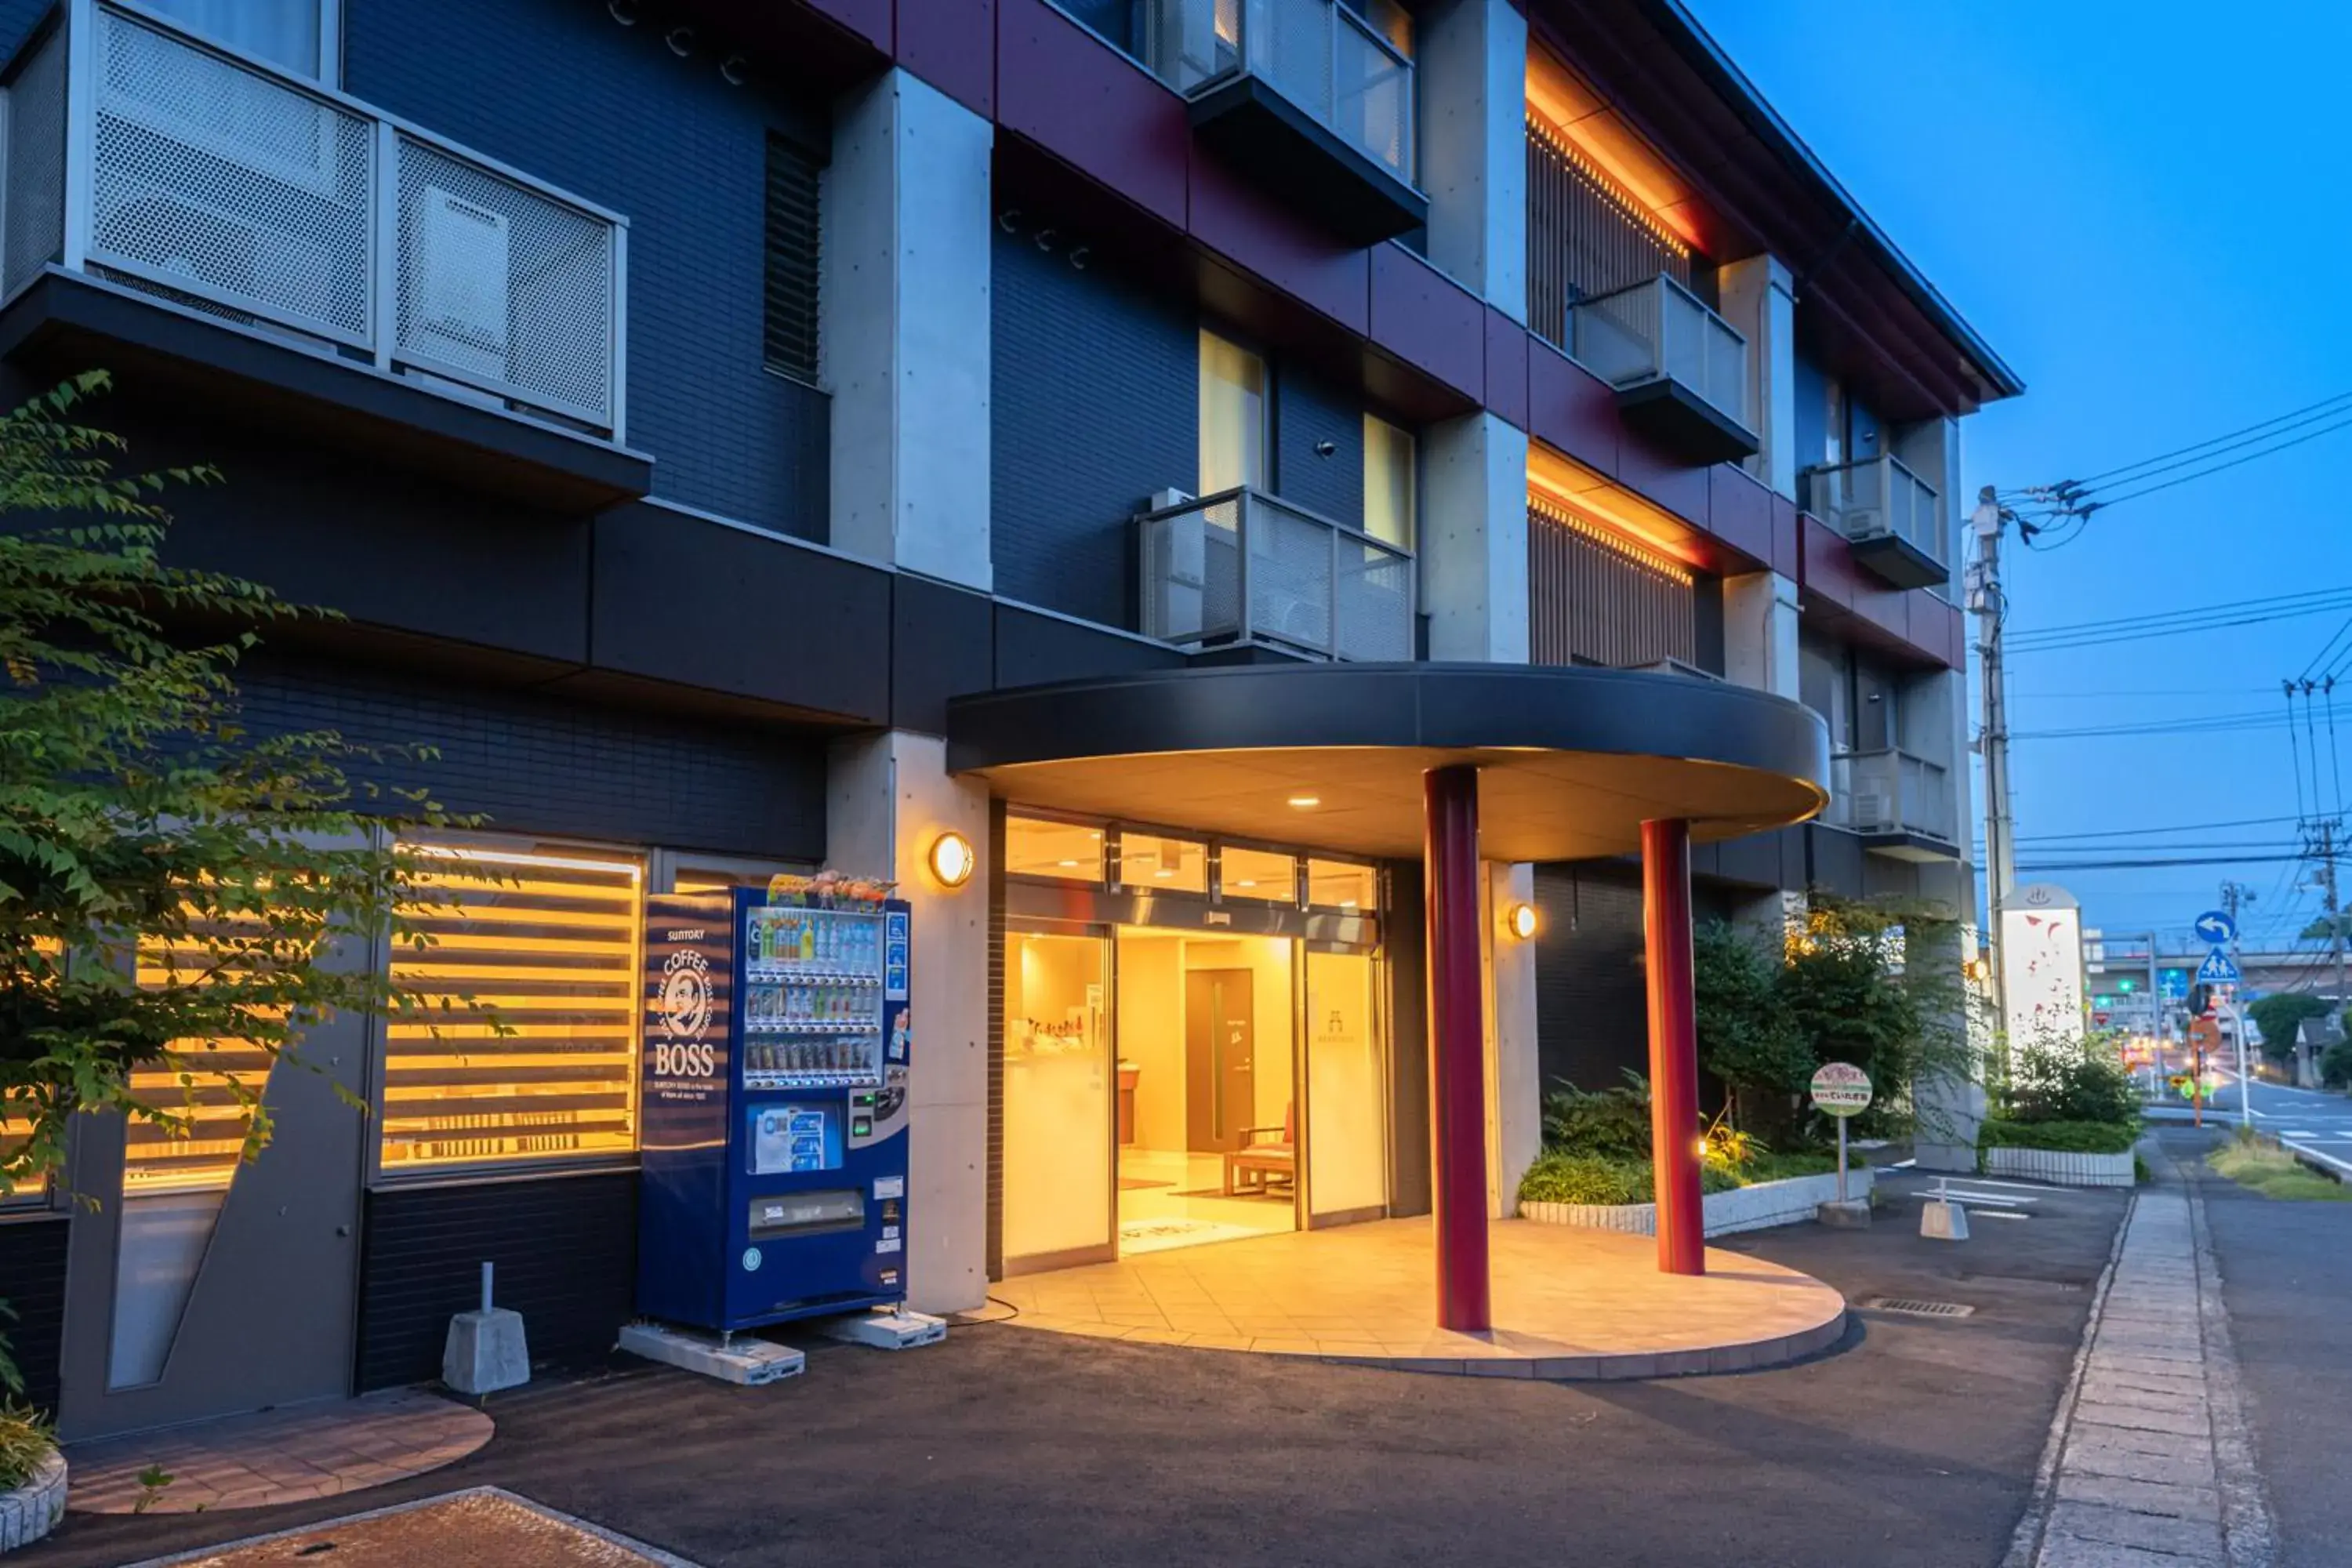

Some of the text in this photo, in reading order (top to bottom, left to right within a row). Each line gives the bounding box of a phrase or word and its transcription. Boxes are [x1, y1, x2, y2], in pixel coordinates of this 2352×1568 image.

[667, 929, 705, 941] SUNTORY
[664, 949, 708, 976] COFFEE
[655, 1044, 714, 1076] BOSS
